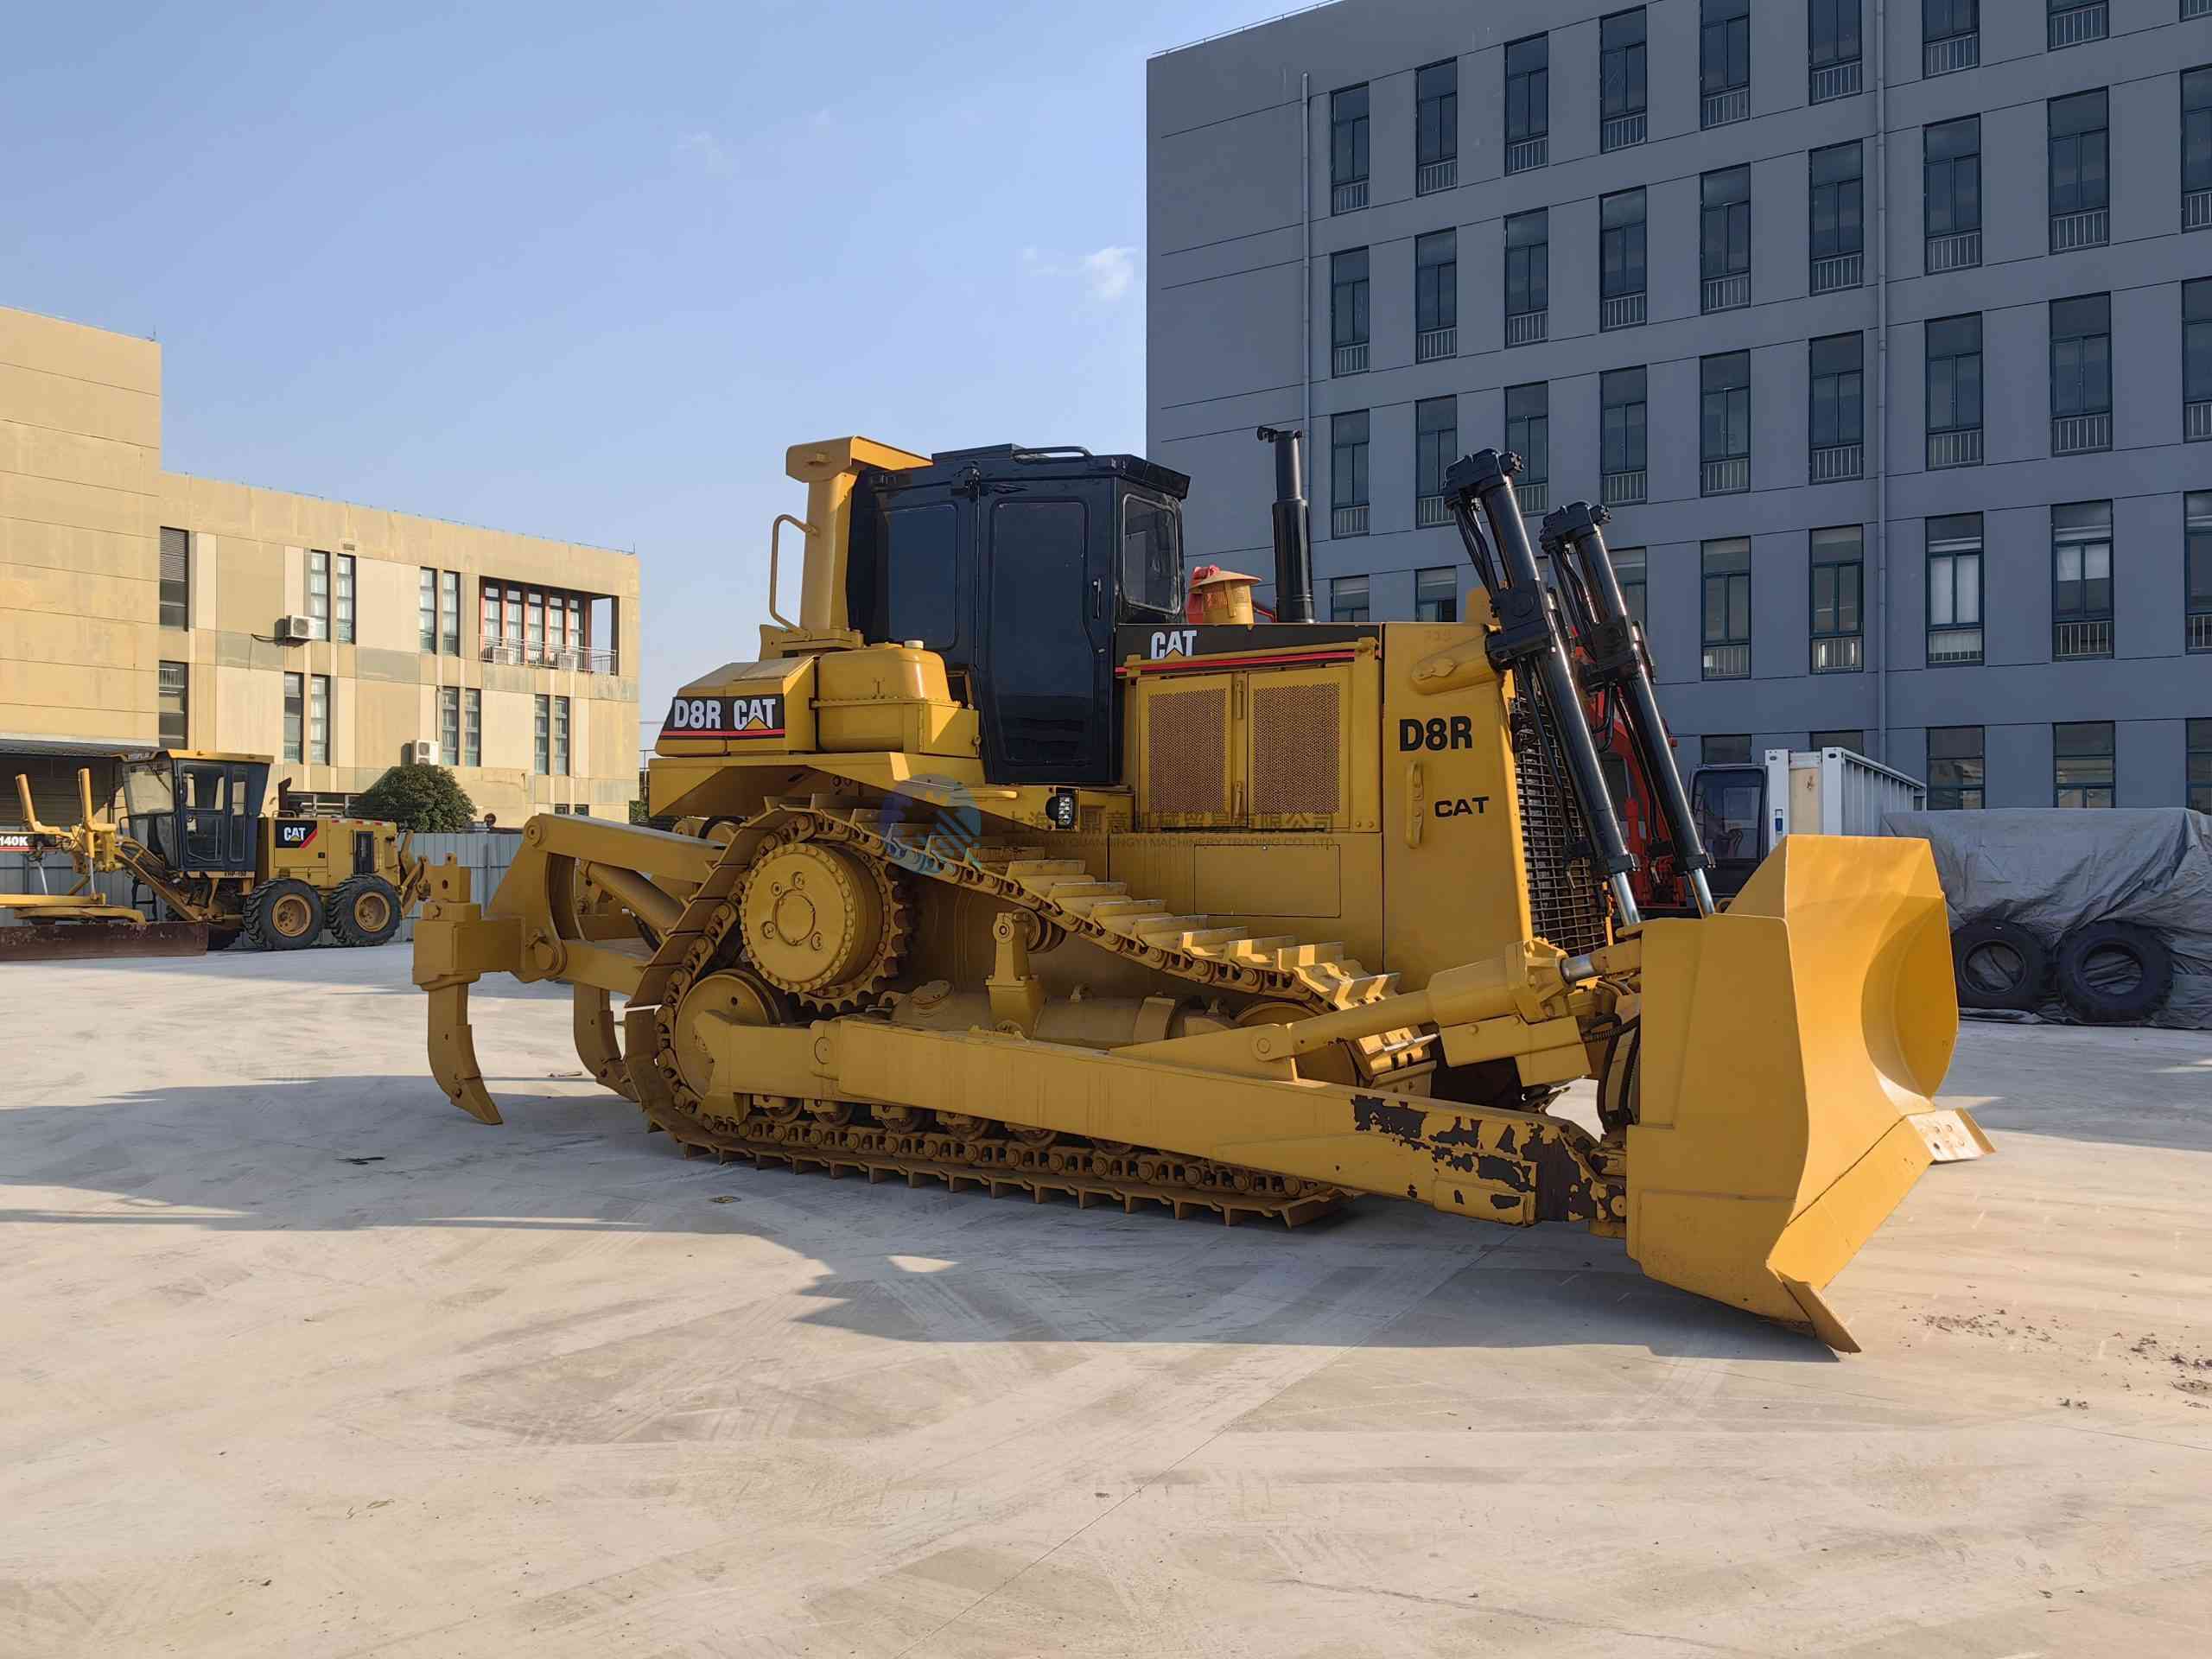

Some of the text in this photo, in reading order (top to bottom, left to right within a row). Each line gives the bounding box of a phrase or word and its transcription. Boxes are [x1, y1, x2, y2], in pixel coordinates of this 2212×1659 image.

[1150, 630, 1198, 659] CAT
[674, 698, 776, 730] D8R CAT
[1399, 715, 1472, 751] D8R
[1434, 796, 1490, 817] CAT
[283, 826, 307, 842] CAT
